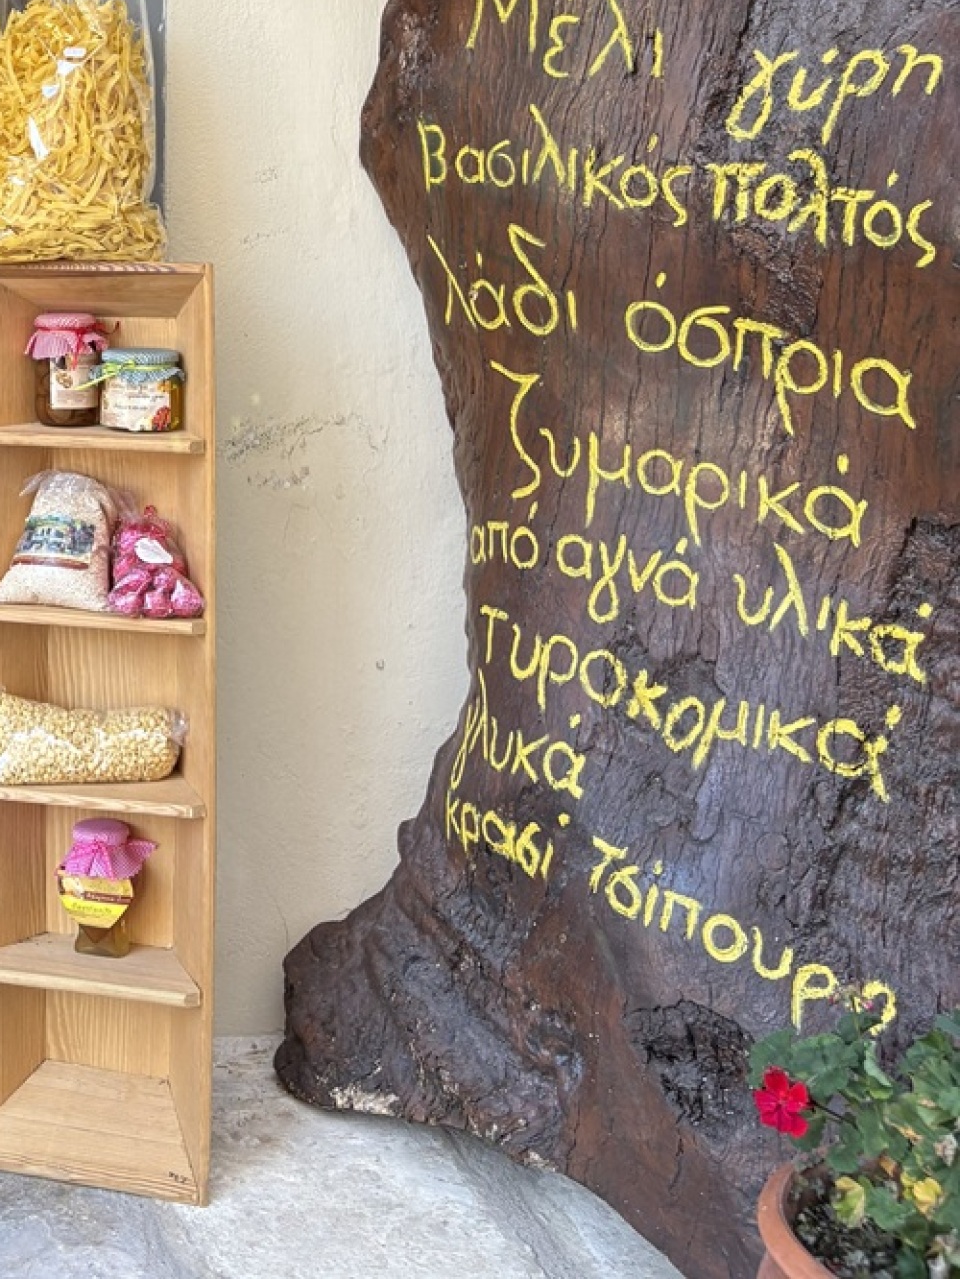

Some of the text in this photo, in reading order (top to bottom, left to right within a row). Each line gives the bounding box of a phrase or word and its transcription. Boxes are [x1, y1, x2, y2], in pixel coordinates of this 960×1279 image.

[725, 43, 944, 146] γύρη
[416, 103, 936, 268] Βασιλικός πολτός
[625, 272, 916, 436] όσπρια
[471, 502, 928, 683] από αγνά υλικά
[450, 667, 587, 800] γλυκά
[445, 790, 571, 879] κρασί
